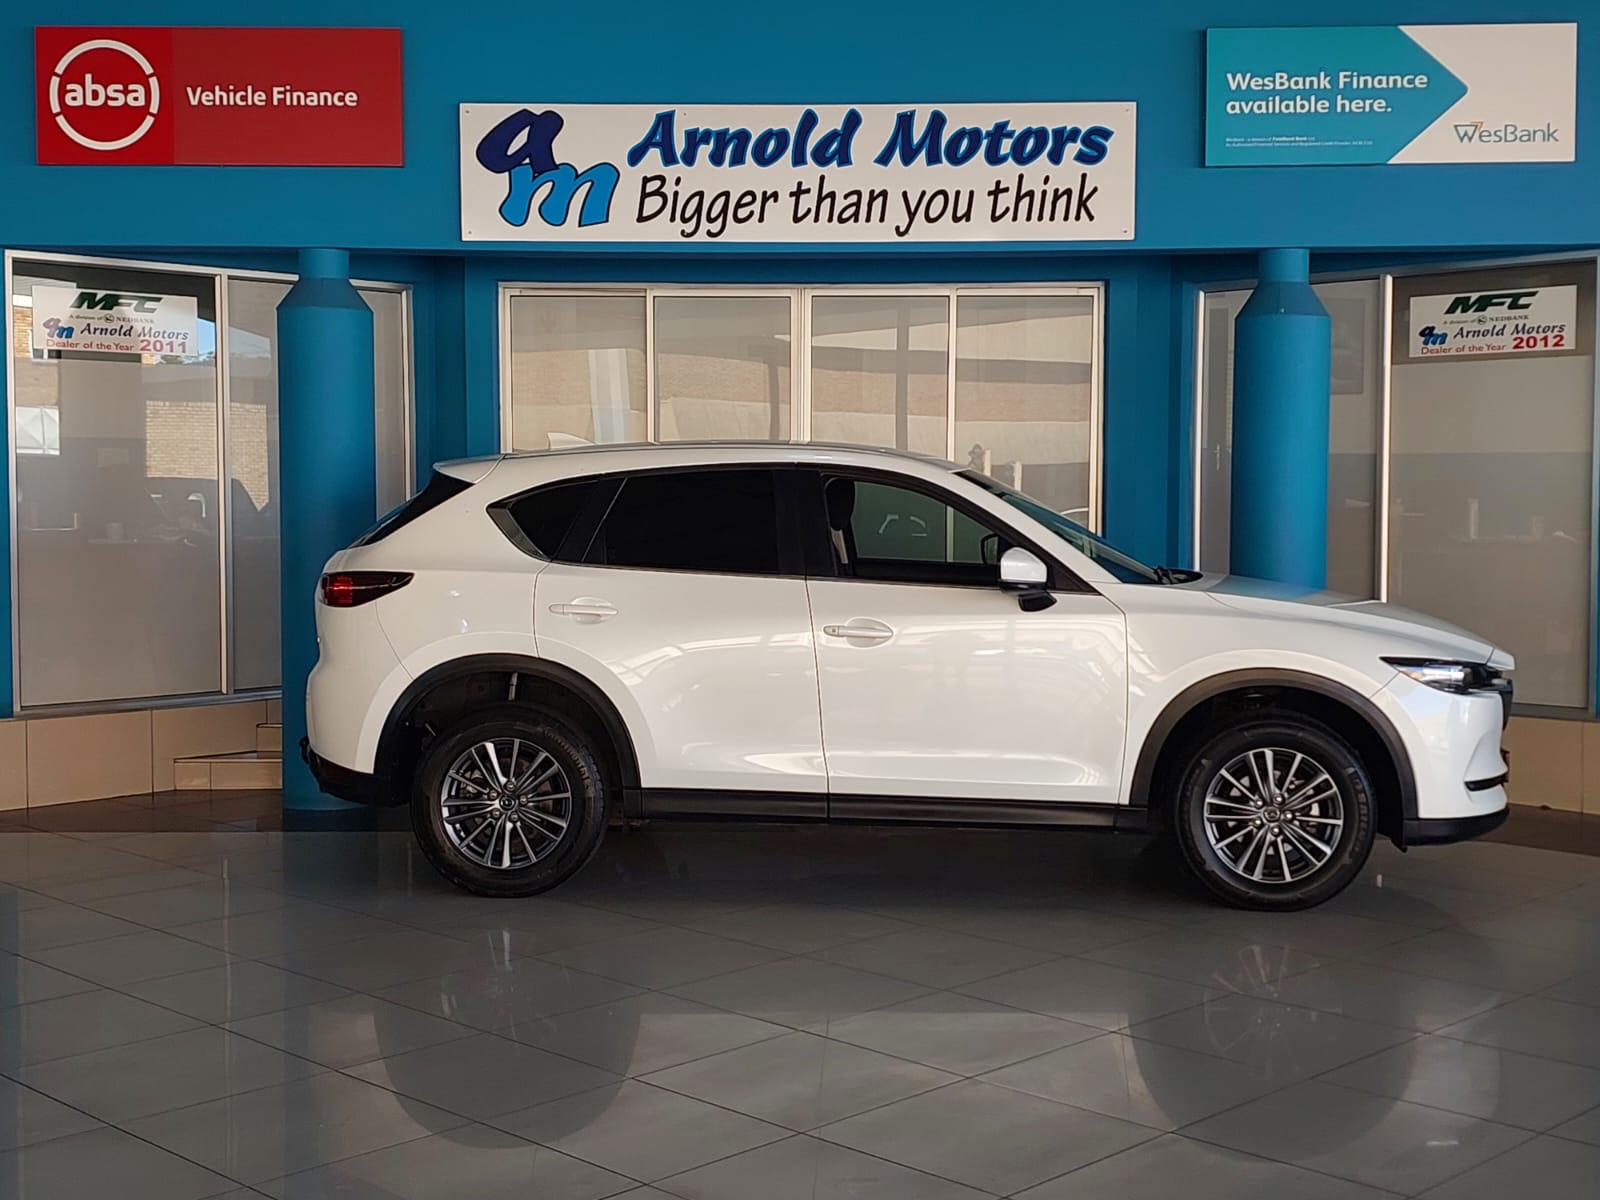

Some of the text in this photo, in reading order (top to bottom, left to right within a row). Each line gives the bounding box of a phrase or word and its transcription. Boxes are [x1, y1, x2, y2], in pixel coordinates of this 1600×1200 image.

[64, 73, 146, 107] absa
[1226, 71, 1428, 91] WesBank Finance
[186, 85, 359, 107] Vehicle Finance
[1226, 95, 1392, 115] available here.
[627, 107, 1115, 168] Arnold Motors
[1453, 121, 1559, 144] WesBank
[636, 173, 1098, 238] Bigger than you think
[70, 291, 163, 313] MFC
[1444, 290, 1540, 315] MFC
[80, 323, 190, 341] Arnold Motors
[1453, 323, 1566, 339] Arnold Motors
[46, 338, 187, 354] Dealer of the Year 2011
[1421, 334, 1565, 355] Dealer of the Year 2012
